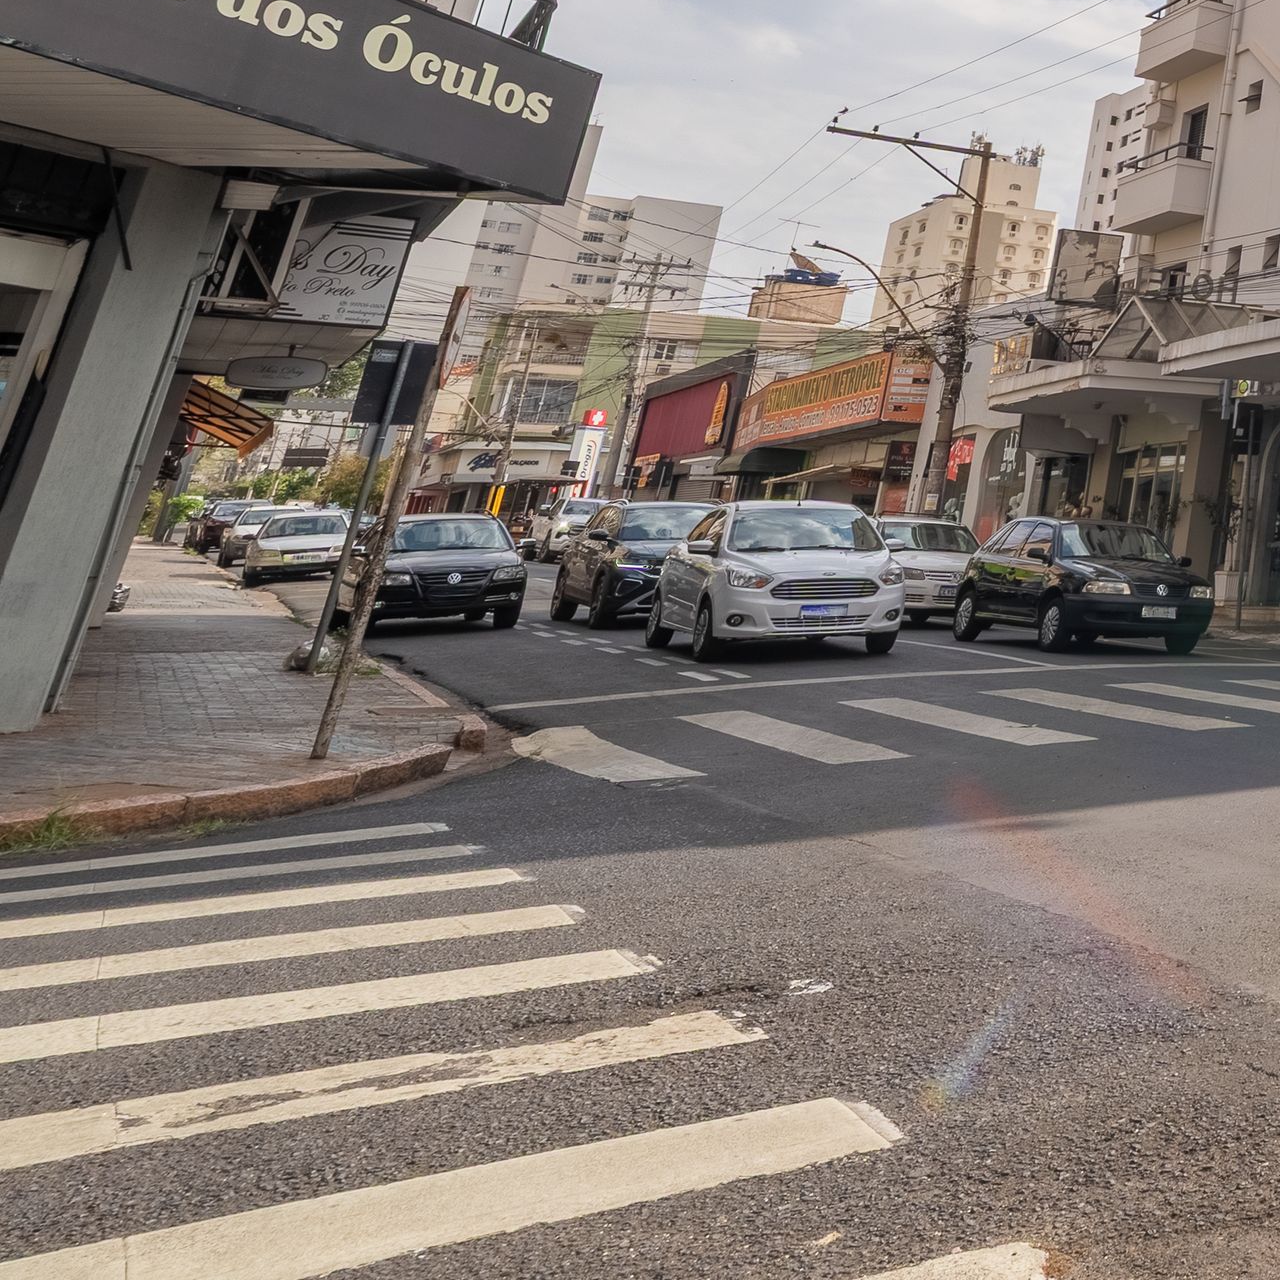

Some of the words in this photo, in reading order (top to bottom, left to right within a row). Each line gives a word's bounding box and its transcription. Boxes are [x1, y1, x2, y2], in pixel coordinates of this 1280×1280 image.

[362, 14, 554, 124] Óculos
[303, 276, 356, 297] Preto
[317, 244, 397, 291] Day
[580, 444, 593, 478] Drogal
